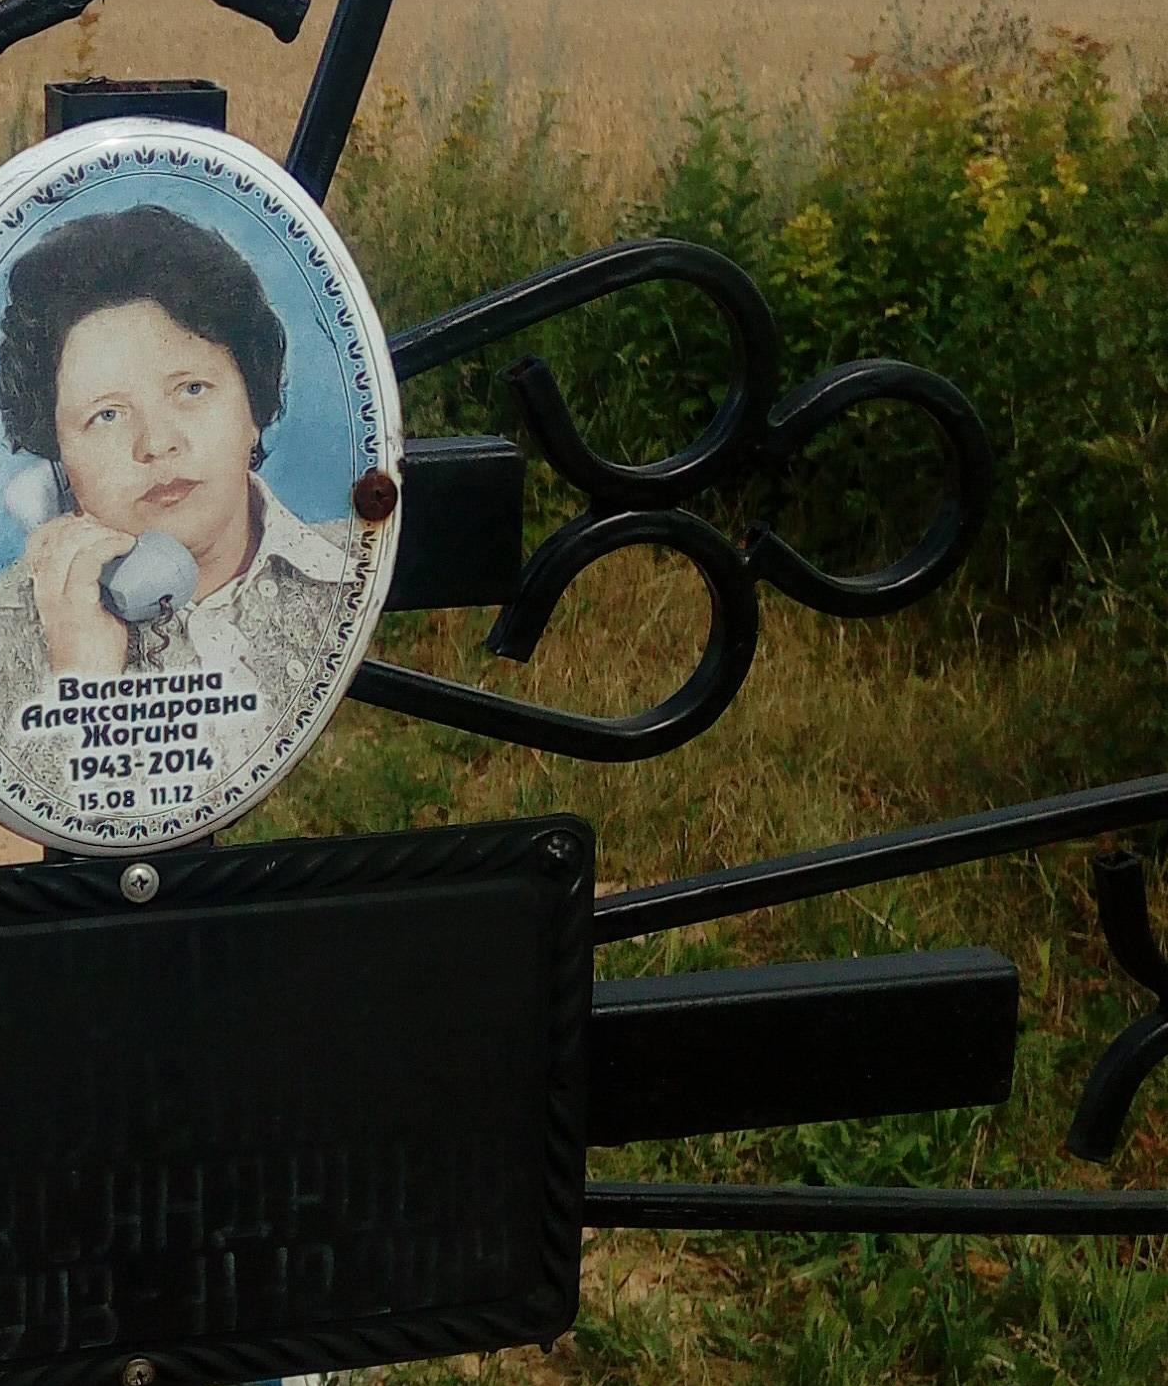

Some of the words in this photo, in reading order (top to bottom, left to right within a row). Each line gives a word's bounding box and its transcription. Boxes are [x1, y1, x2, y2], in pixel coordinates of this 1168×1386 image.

[58, 671, 223, 701] Валентина
[21, 692, 257, 731] Александровна
[81, 721, 198, 749] Жогина
[68, 747, 214, 781] 1943-2014
[79, 789, 135, 811] 15.08
[150, 785, 194, 807] 11.12
